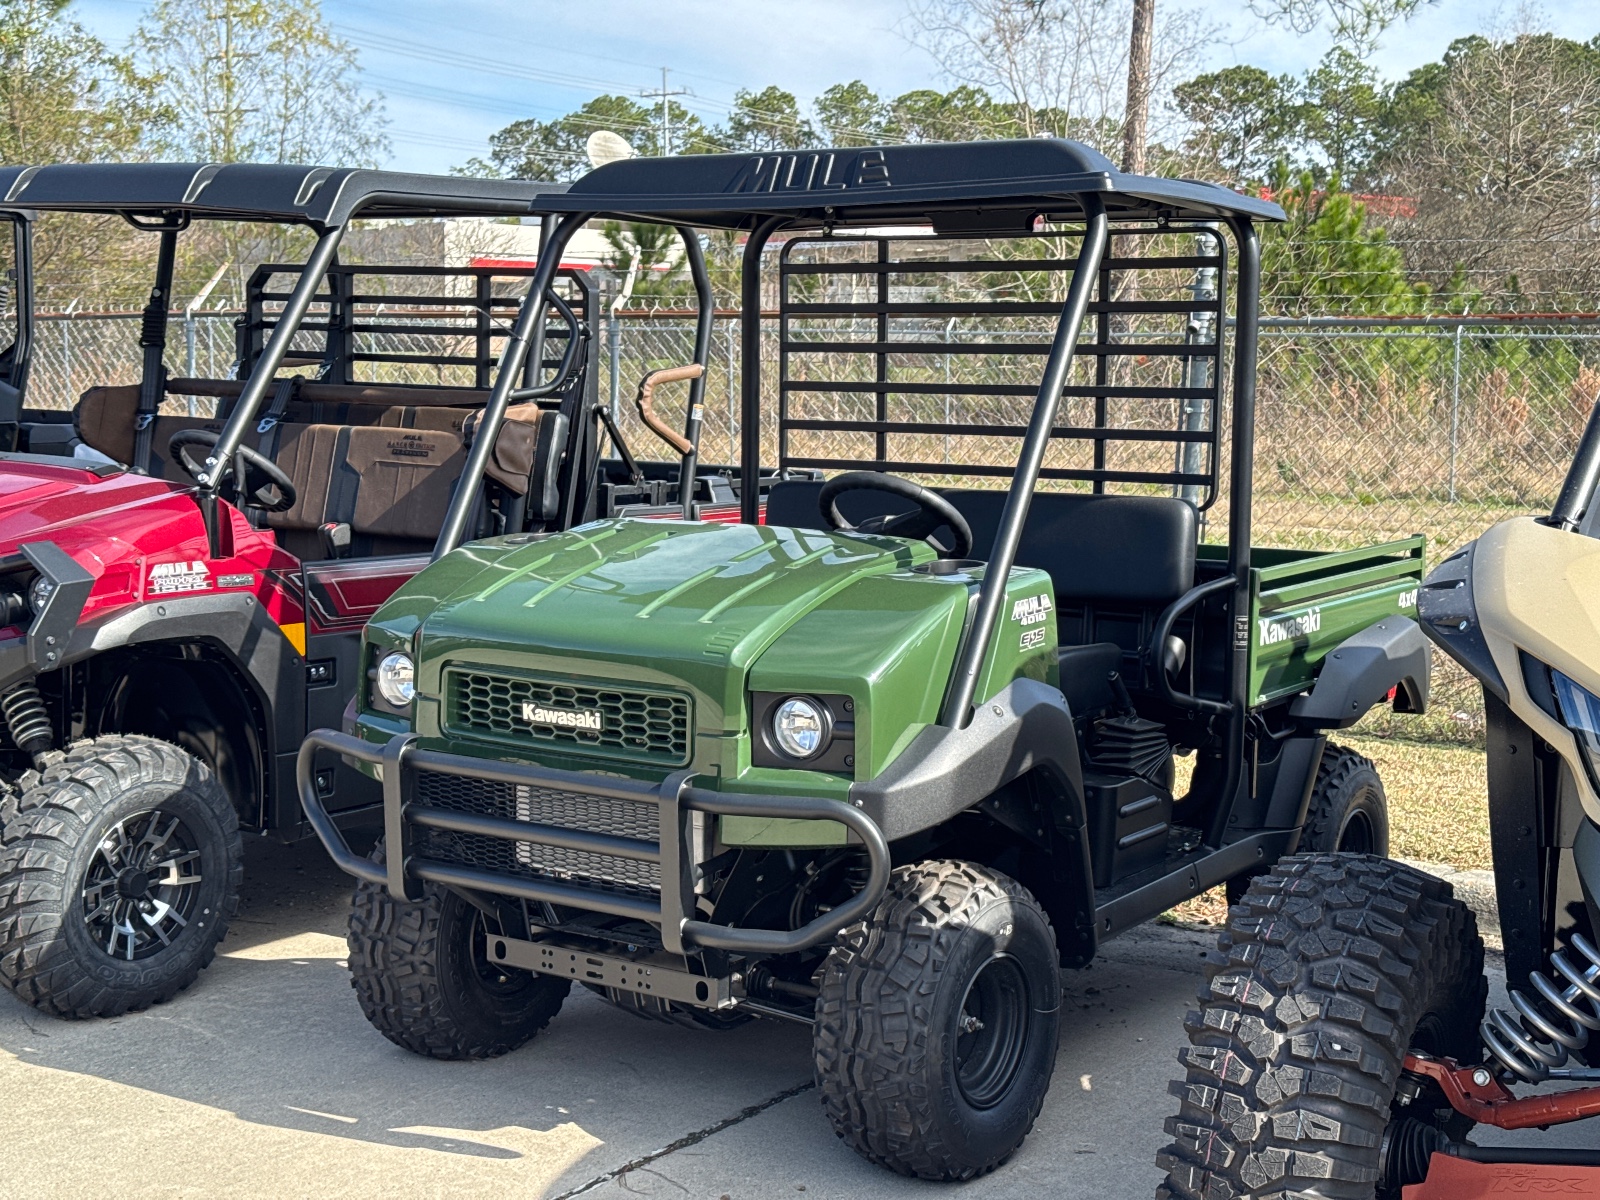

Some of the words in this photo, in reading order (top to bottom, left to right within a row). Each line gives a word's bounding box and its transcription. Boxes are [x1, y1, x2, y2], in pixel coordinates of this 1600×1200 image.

[721, 150, 892, 193] MULE
[147, 561, 211, 581] MULE
[1011, 594, 1053, 621] MULE
[1020, 612, 1047, 625] 4010
[1258, 606, 1320, 647] Kawasaki
[522, 703, 601, 729] Kawasaki
[96, 953, 181, 985] DURO
[1490, 1175, 1593, 1194] KRX
